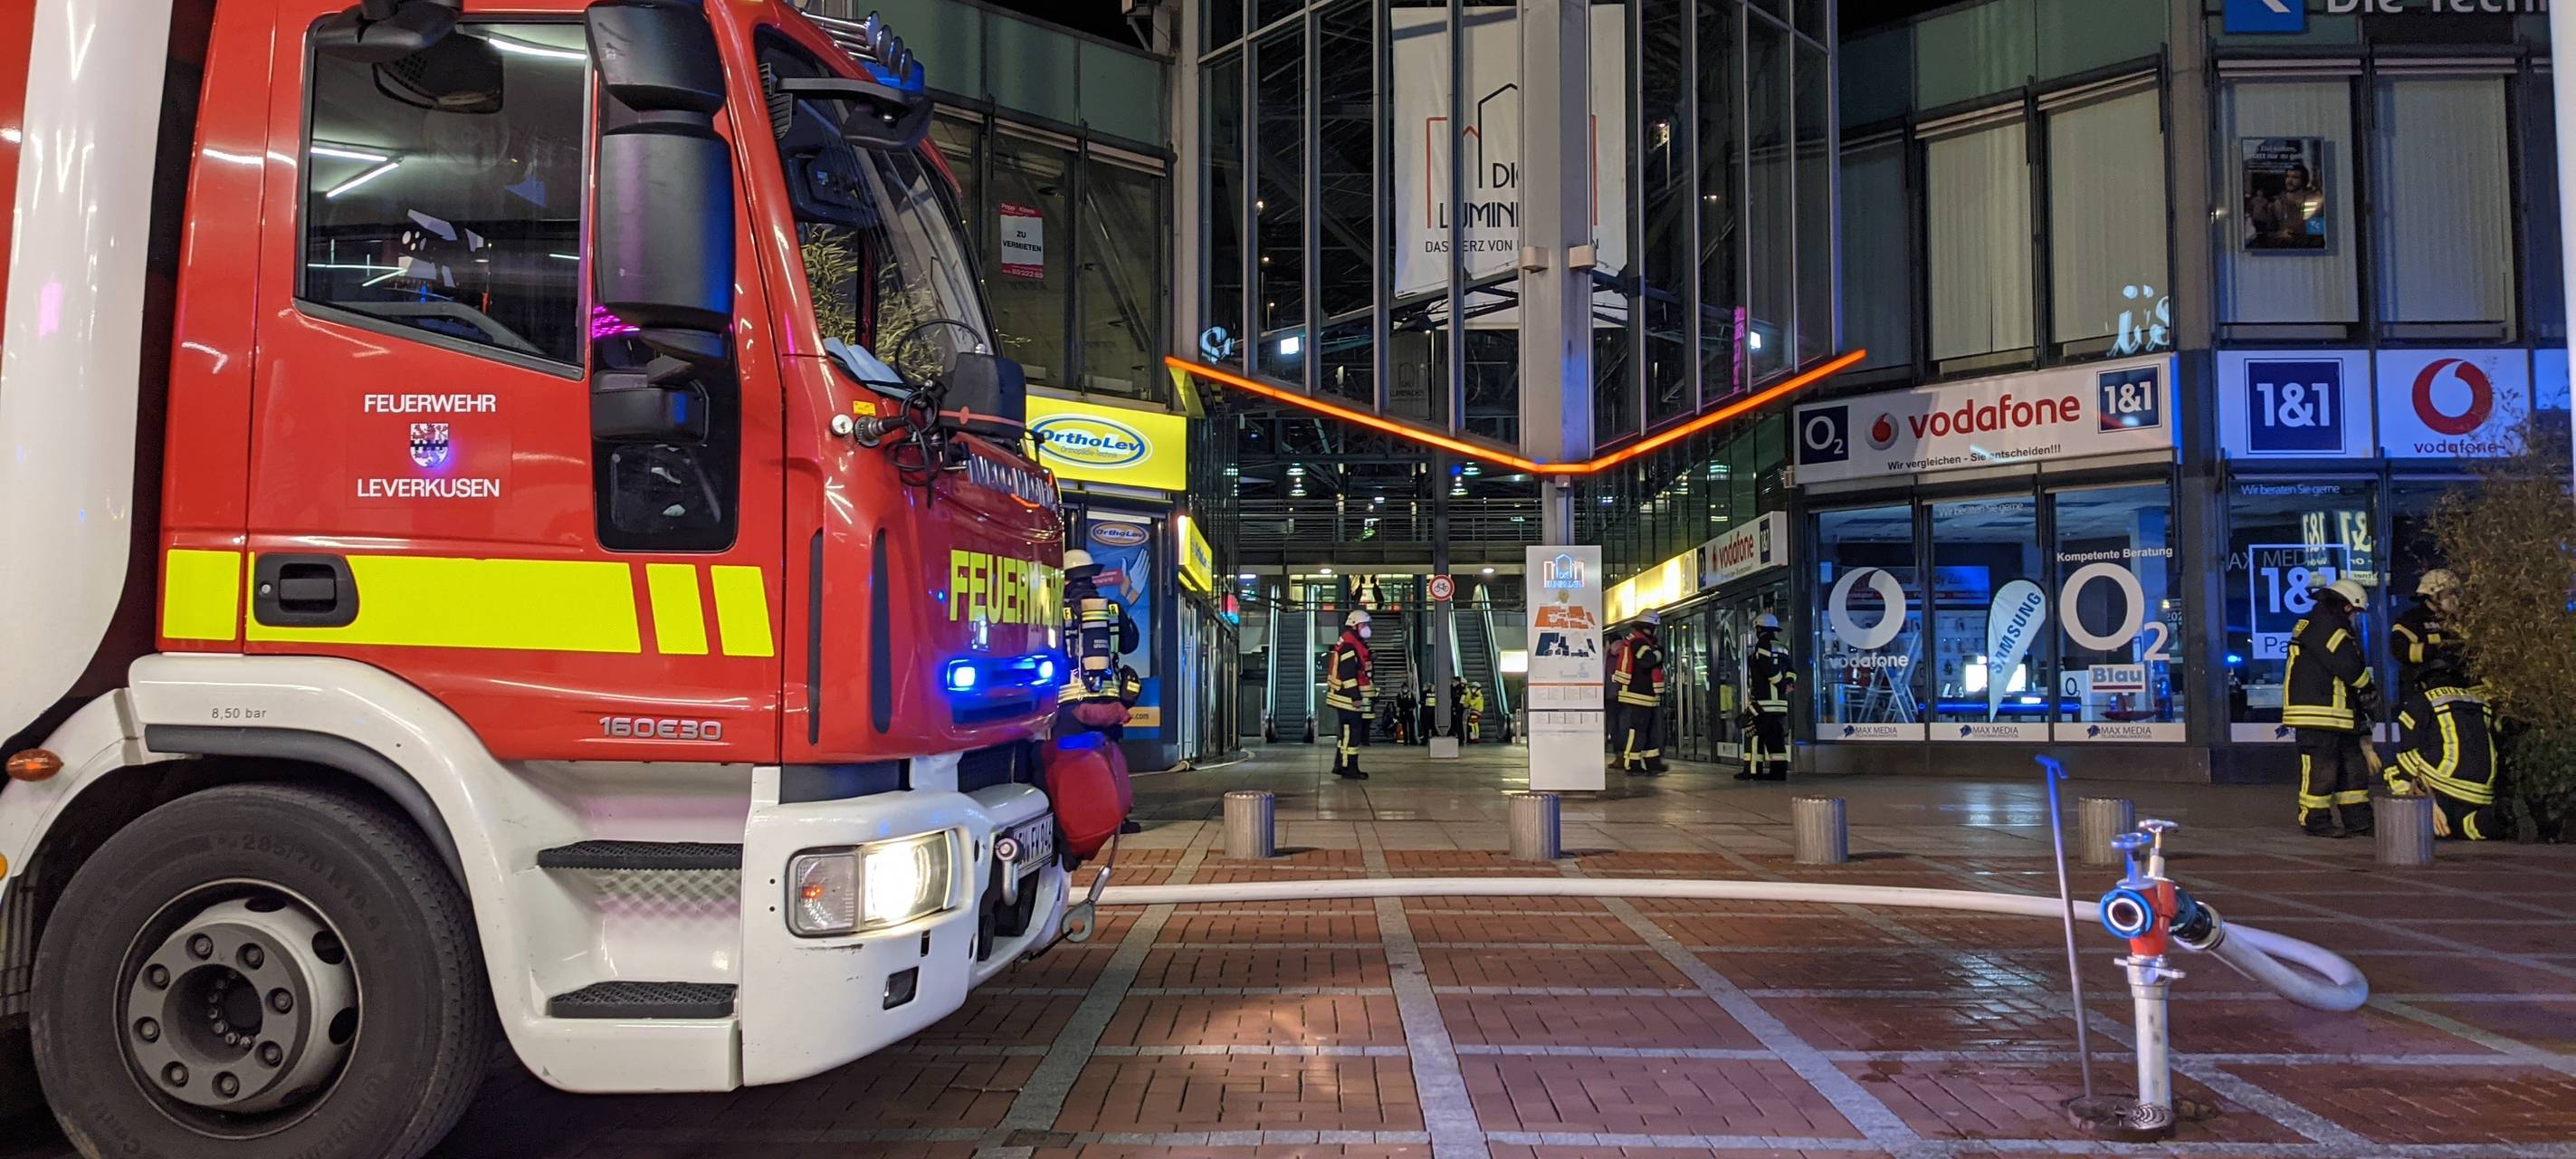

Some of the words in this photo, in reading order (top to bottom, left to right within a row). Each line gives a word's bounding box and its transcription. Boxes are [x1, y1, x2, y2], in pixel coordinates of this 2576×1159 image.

[1493, 162, 1519, 189] DI
[1016, 230, 1026, 239] ZU
[1002, 240, 1042, 253] VERMIETEN
[1425, 241, 1448, 254] DAS
[1463, 240, 1485, 253] ERZ
[1488, 239, 1513, 252] VON
[363, 394, 497, 413] FEUERWEHR
[1908, 394, 2080, 439] vodafone
[2104, 380, 2151, 416] 1&1
[2256, 382, 2331, 427] 1&1
[1041, 429, 1140, 452] OrthoLev
[2413, 439, 2496, 455] vodafone
[1887, 461, 1903, 471] Wir
[1905, 455, 1961, 469] vergleichen
[1970, 452, 1987, 462] Sie
[1989, 444, 2062, 461] entscheiden!!!
[357, 478, 501, 498] LEVERKUSEN
[2240, 484, 2258, 495] Wir
[2259, 484, 2296, 494] beraten
[1719, 530, 1755, 570] vodafone
[2056, 551, 2120, 563] Kompetente
[2123, 547, 2173, 559] Beratung
[2229, 551, 2256, 572] AX
[1990, 591, 2042, 675] SAMSUNG
[2265, 637, 2290, 654] Pa
[1829, 651, 1909, 668] vodafone
[2092, 666, 2142, 683] Blau
[211, 707, 241, 720] 8,50
[245, 707, 267, 718] bar
[598, 716, 723, 741] 160E30
[1992, 726, 2018, 734] MEDIA
[2101, 726, 2121, 734] MAX
[2123, 726, 2151, 734] MEDIA
